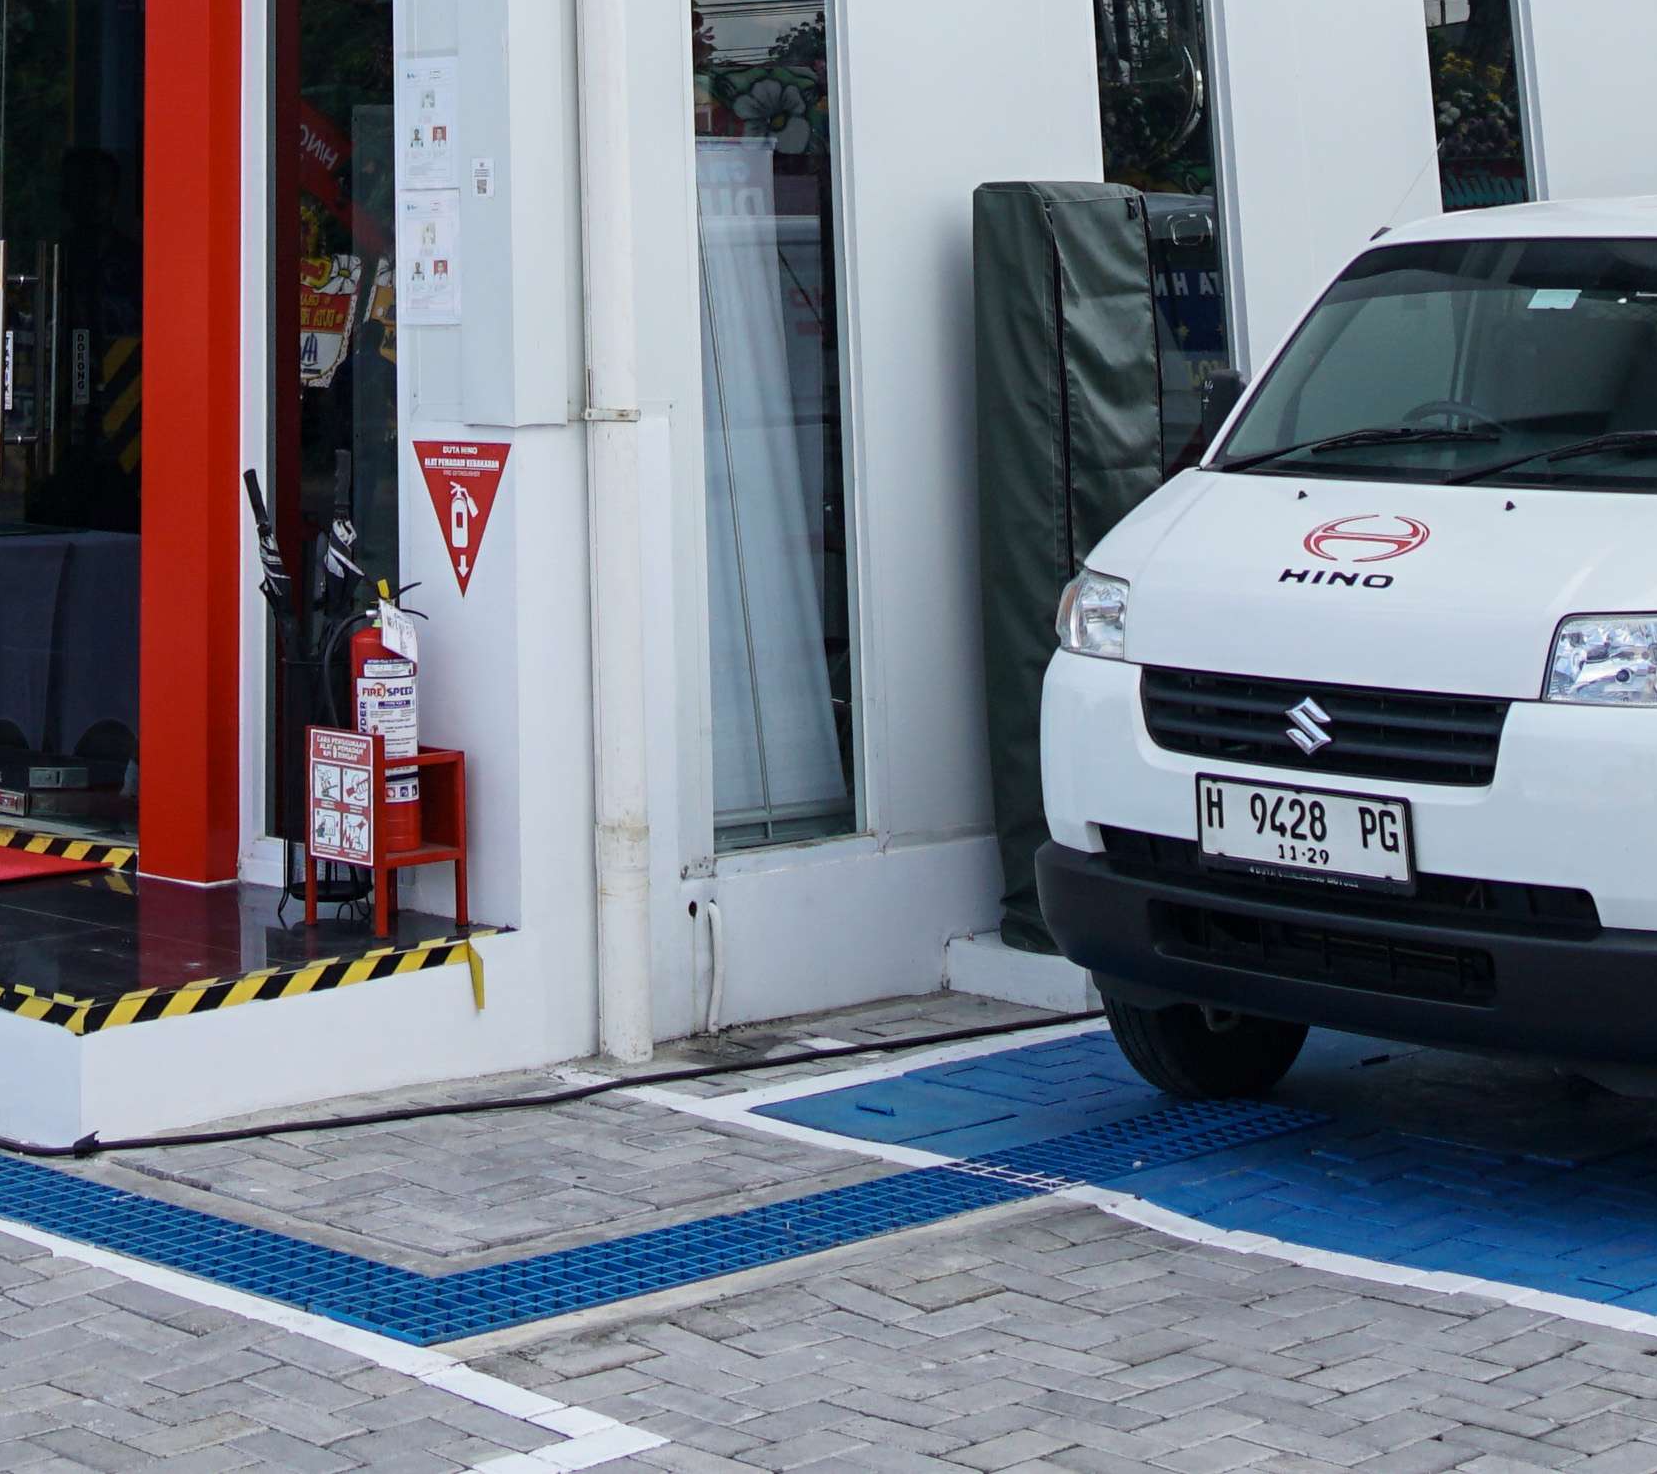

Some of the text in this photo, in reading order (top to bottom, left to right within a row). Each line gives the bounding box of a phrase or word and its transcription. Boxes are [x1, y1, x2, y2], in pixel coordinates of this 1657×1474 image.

[77, 334, 85, 390] DORONG
[1278, 567, 1394, 589] HINO
[386, 686, 413, 697] SPEED
[1206, 787, 1400, 853] H 9428 PG
